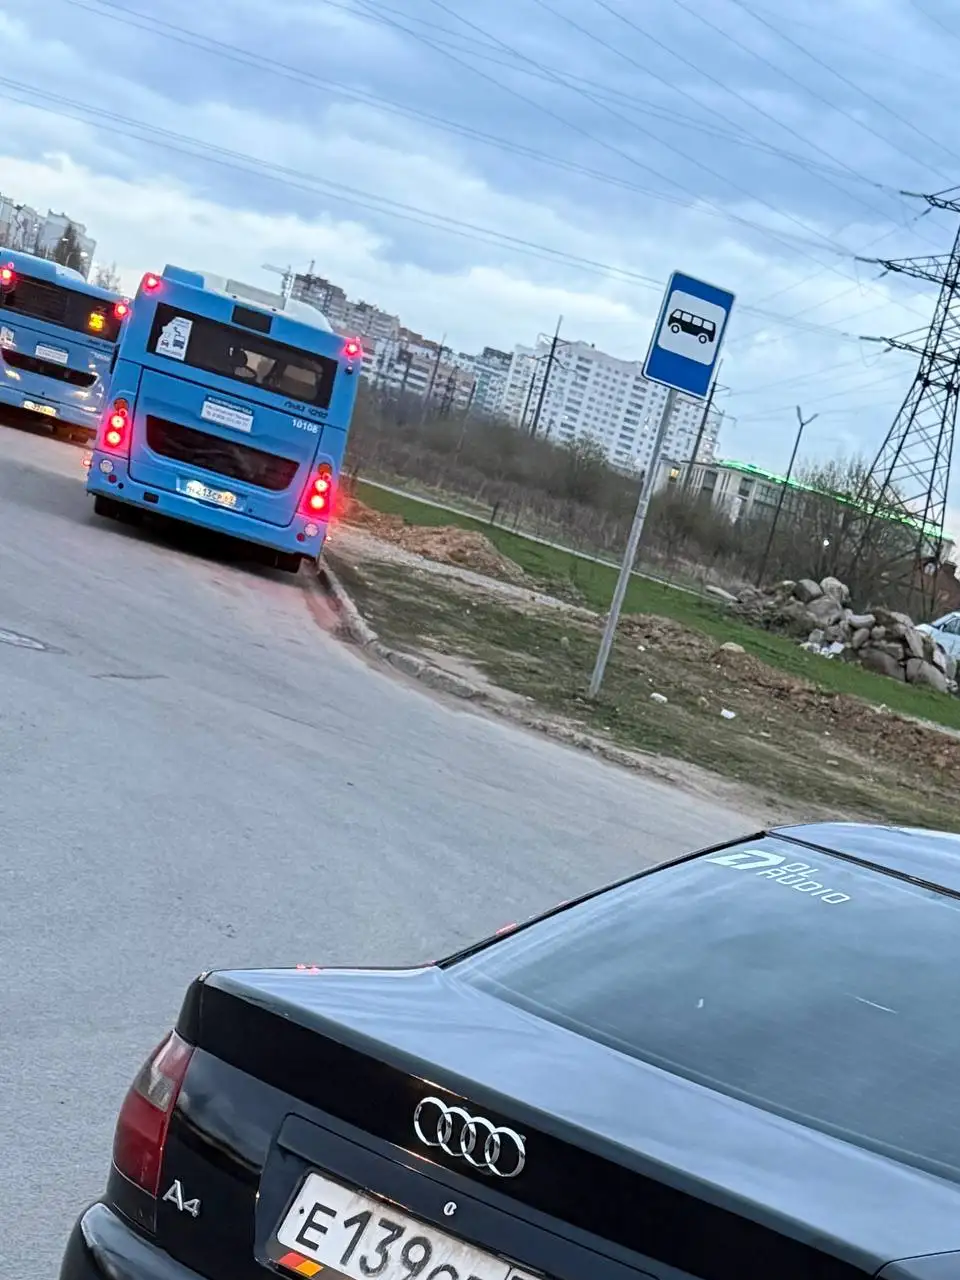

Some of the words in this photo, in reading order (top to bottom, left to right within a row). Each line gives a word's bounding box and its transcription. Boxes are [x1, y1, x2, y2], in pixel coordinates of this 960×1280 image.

[755, 868, 851, 905] AUDIO
[782, 862, 819, 878] DL
[162, 1179, 200, 1218] A4
